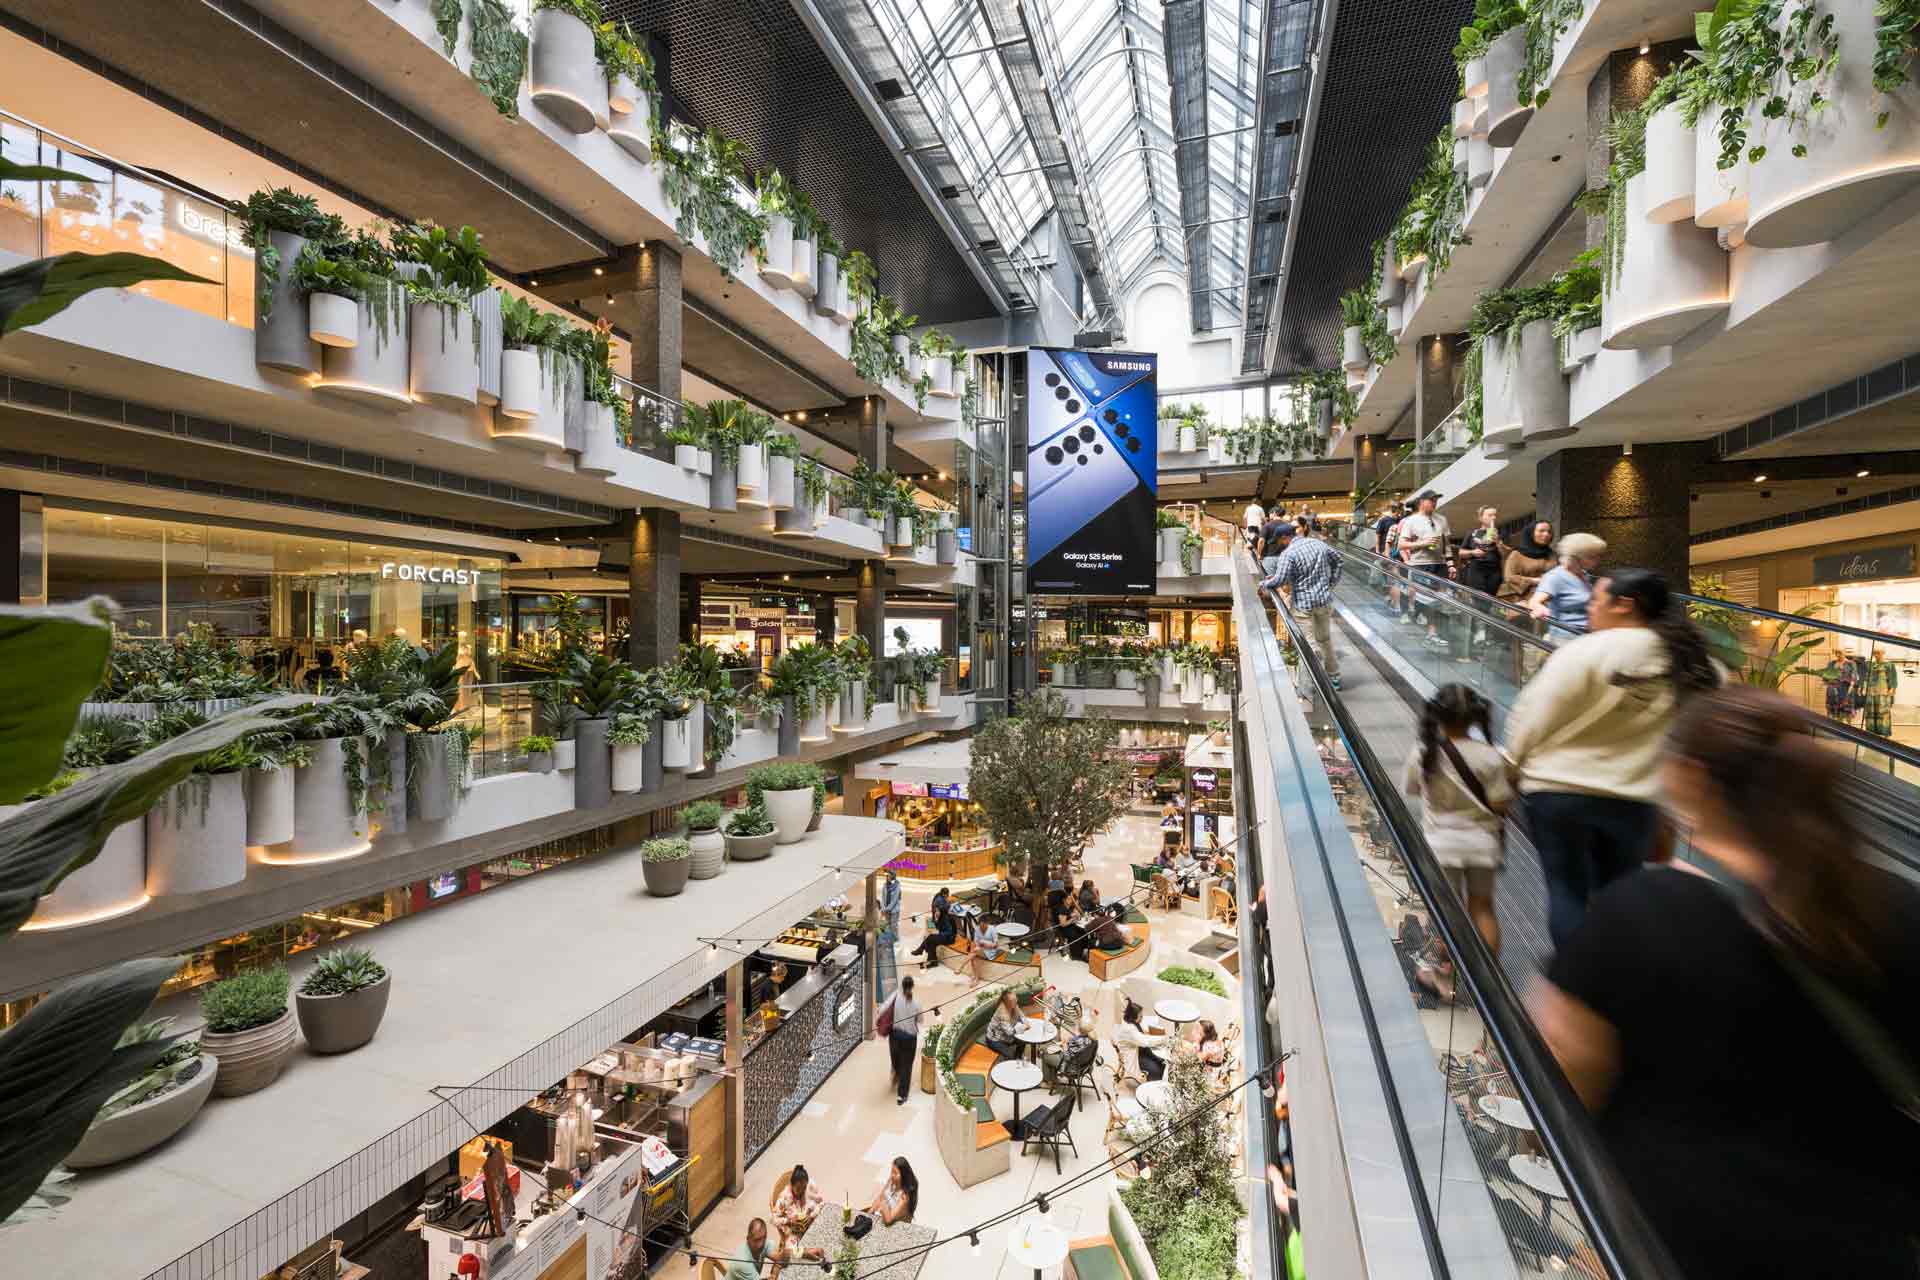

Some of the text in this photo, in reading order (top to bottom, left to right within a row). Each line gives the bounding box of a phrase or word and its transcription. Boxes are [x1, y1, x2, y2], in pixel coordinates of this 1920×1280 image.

[1107, 360, 1152, 372] SAMSUNG
[1063, 552, 1123, 562] Galaxy S25 Series
[1075, 562, 1097, 571] Galaxy
[1840, 555, 1879, 578] ideas
[382, 562, 480, 585] FORCAST
[751, 619, 797, 628] goldmrk
